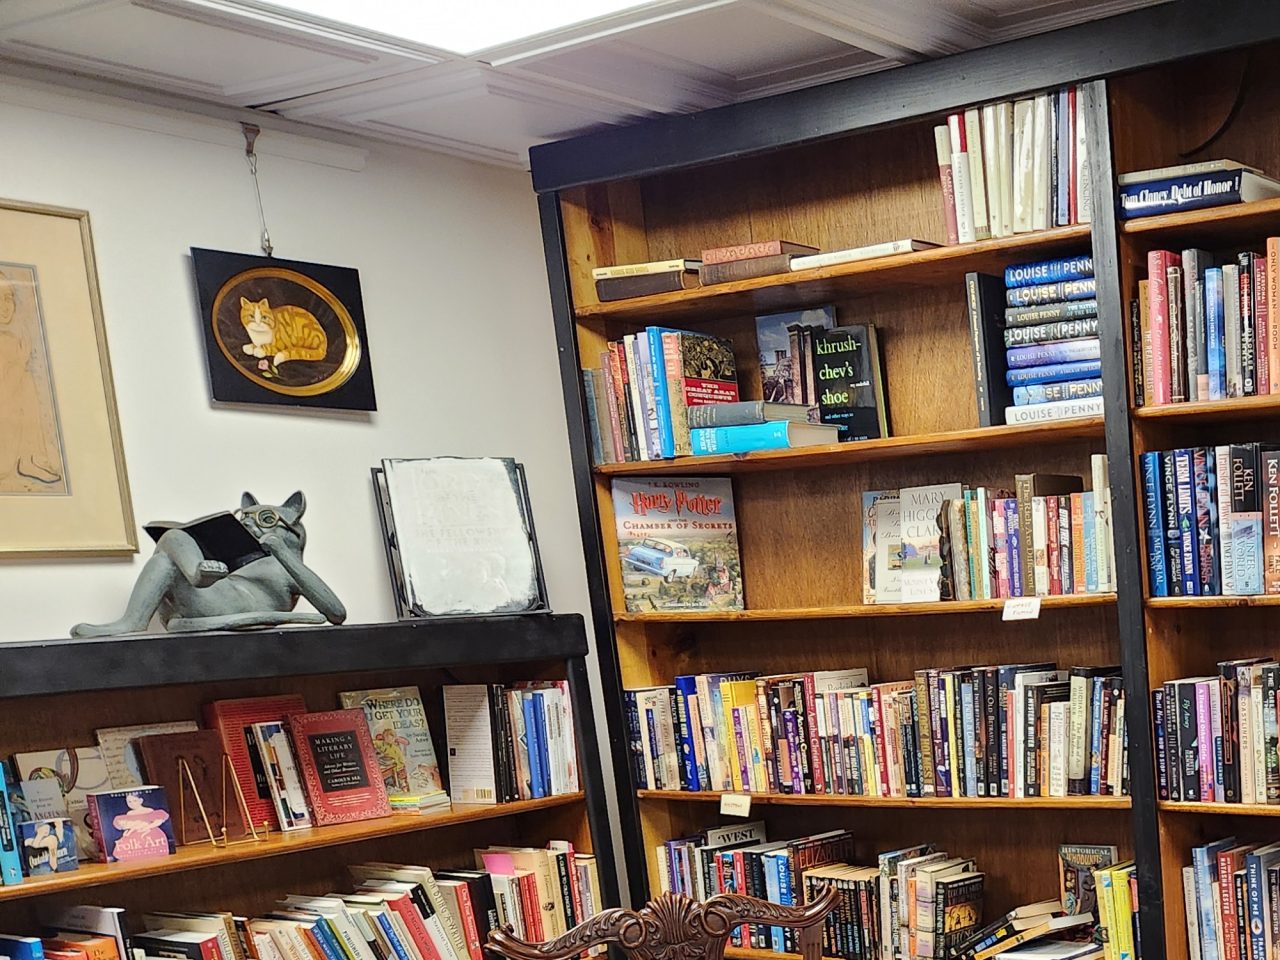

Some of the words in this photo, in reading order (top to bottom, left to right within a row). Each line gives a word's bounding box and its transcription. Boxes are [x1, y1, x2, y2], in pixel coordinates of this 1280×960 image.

[1121, 193, 1138, 208] Tom
[1139, 188, 1168, 208] Clancy
[1172, 183, 1192, 201] Debt
[1203, 180, 1233, 196] Honor
[1009, 266, 1048, 281] LOUISE
[1016, 287, 1057, 301] LOUISE
[1017, 313, 1039, 321] LOUISE
[1040, 310, 1060, 318] PENNY
[1009, 327, 1046, 341] LOUISE
[1062, 320, 1098, 335] PENNY
[816, 335, 862, 356] khrush-
[818, 362, 854, 382] chev's
[821, 390, 848, 405] shoe
[1014, 410, 1052, 422] LOUISE
[1232, 458, 1244, 502] FOLLETT
[1243, 468, 1254, 490] KEN
[1267, 458, 1279, 492] KEN
[632, 491, 673, 516] Harry
[674, 490, 722, 516] Potter
[911, 491, 946, 504] MARY
[1267, 493, 1280, 538] FOLLETT
[623, 520, 674, 530] CHAMBER
[676, 521, 688, 529] OF
[691, 521, 733, 530] SECRETS
[366, 699, 404, 711] WHERE
[405, 698, 420, 707] DO
[375, 711, 394, 721] GET
[397, 708, 422, 719] YOUR
[393, 720, 424, 729] IDEAS?
[317, 743, 353, 752] LITERARY
[116, 840, 142, 851] Folk
[145, 837, 166, 848] Art
[1061, 847, 1110, 855] HISTORICAL
